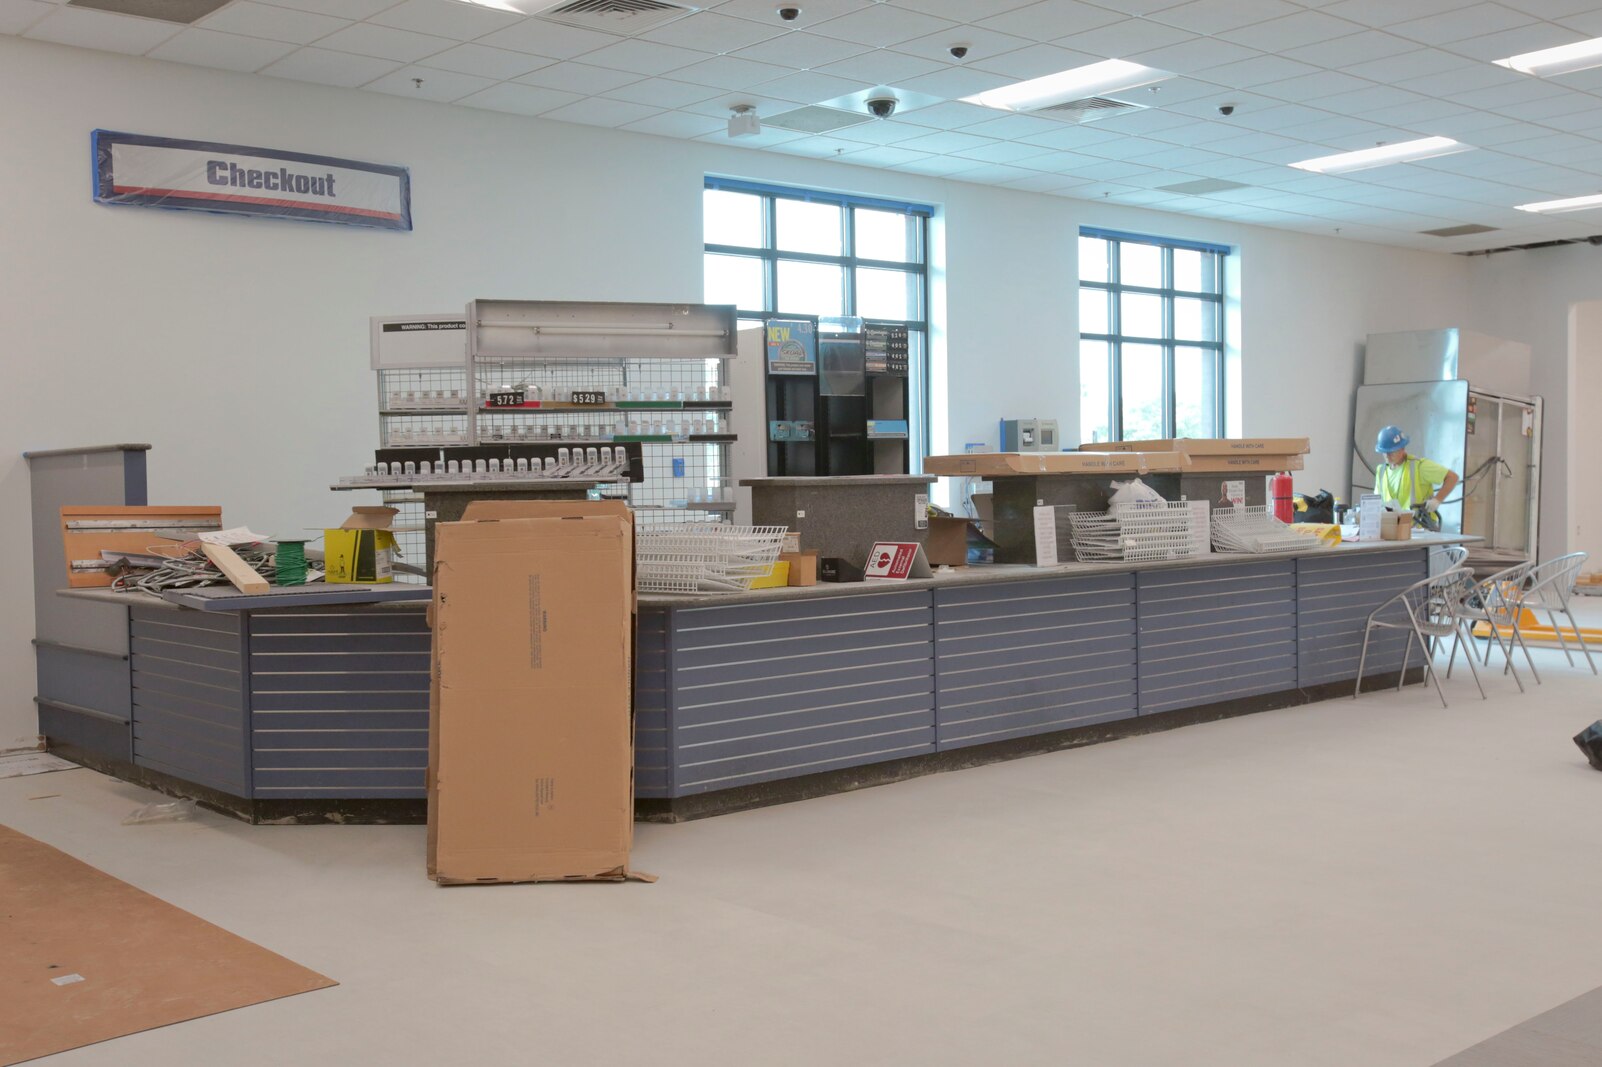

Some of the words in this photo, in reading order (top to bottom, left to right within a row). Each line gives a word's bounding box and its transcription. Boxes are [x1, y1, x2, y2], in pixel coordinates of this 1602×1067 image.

[207, 160, 336, 197] Checkout
[768, 327, 790, 341] NEW
[573, 394, 596, 403] $529
[870, 551, 881, 568] AED
[891, 549, 904, 574] Automated
[895, 556, 905, 574] External
